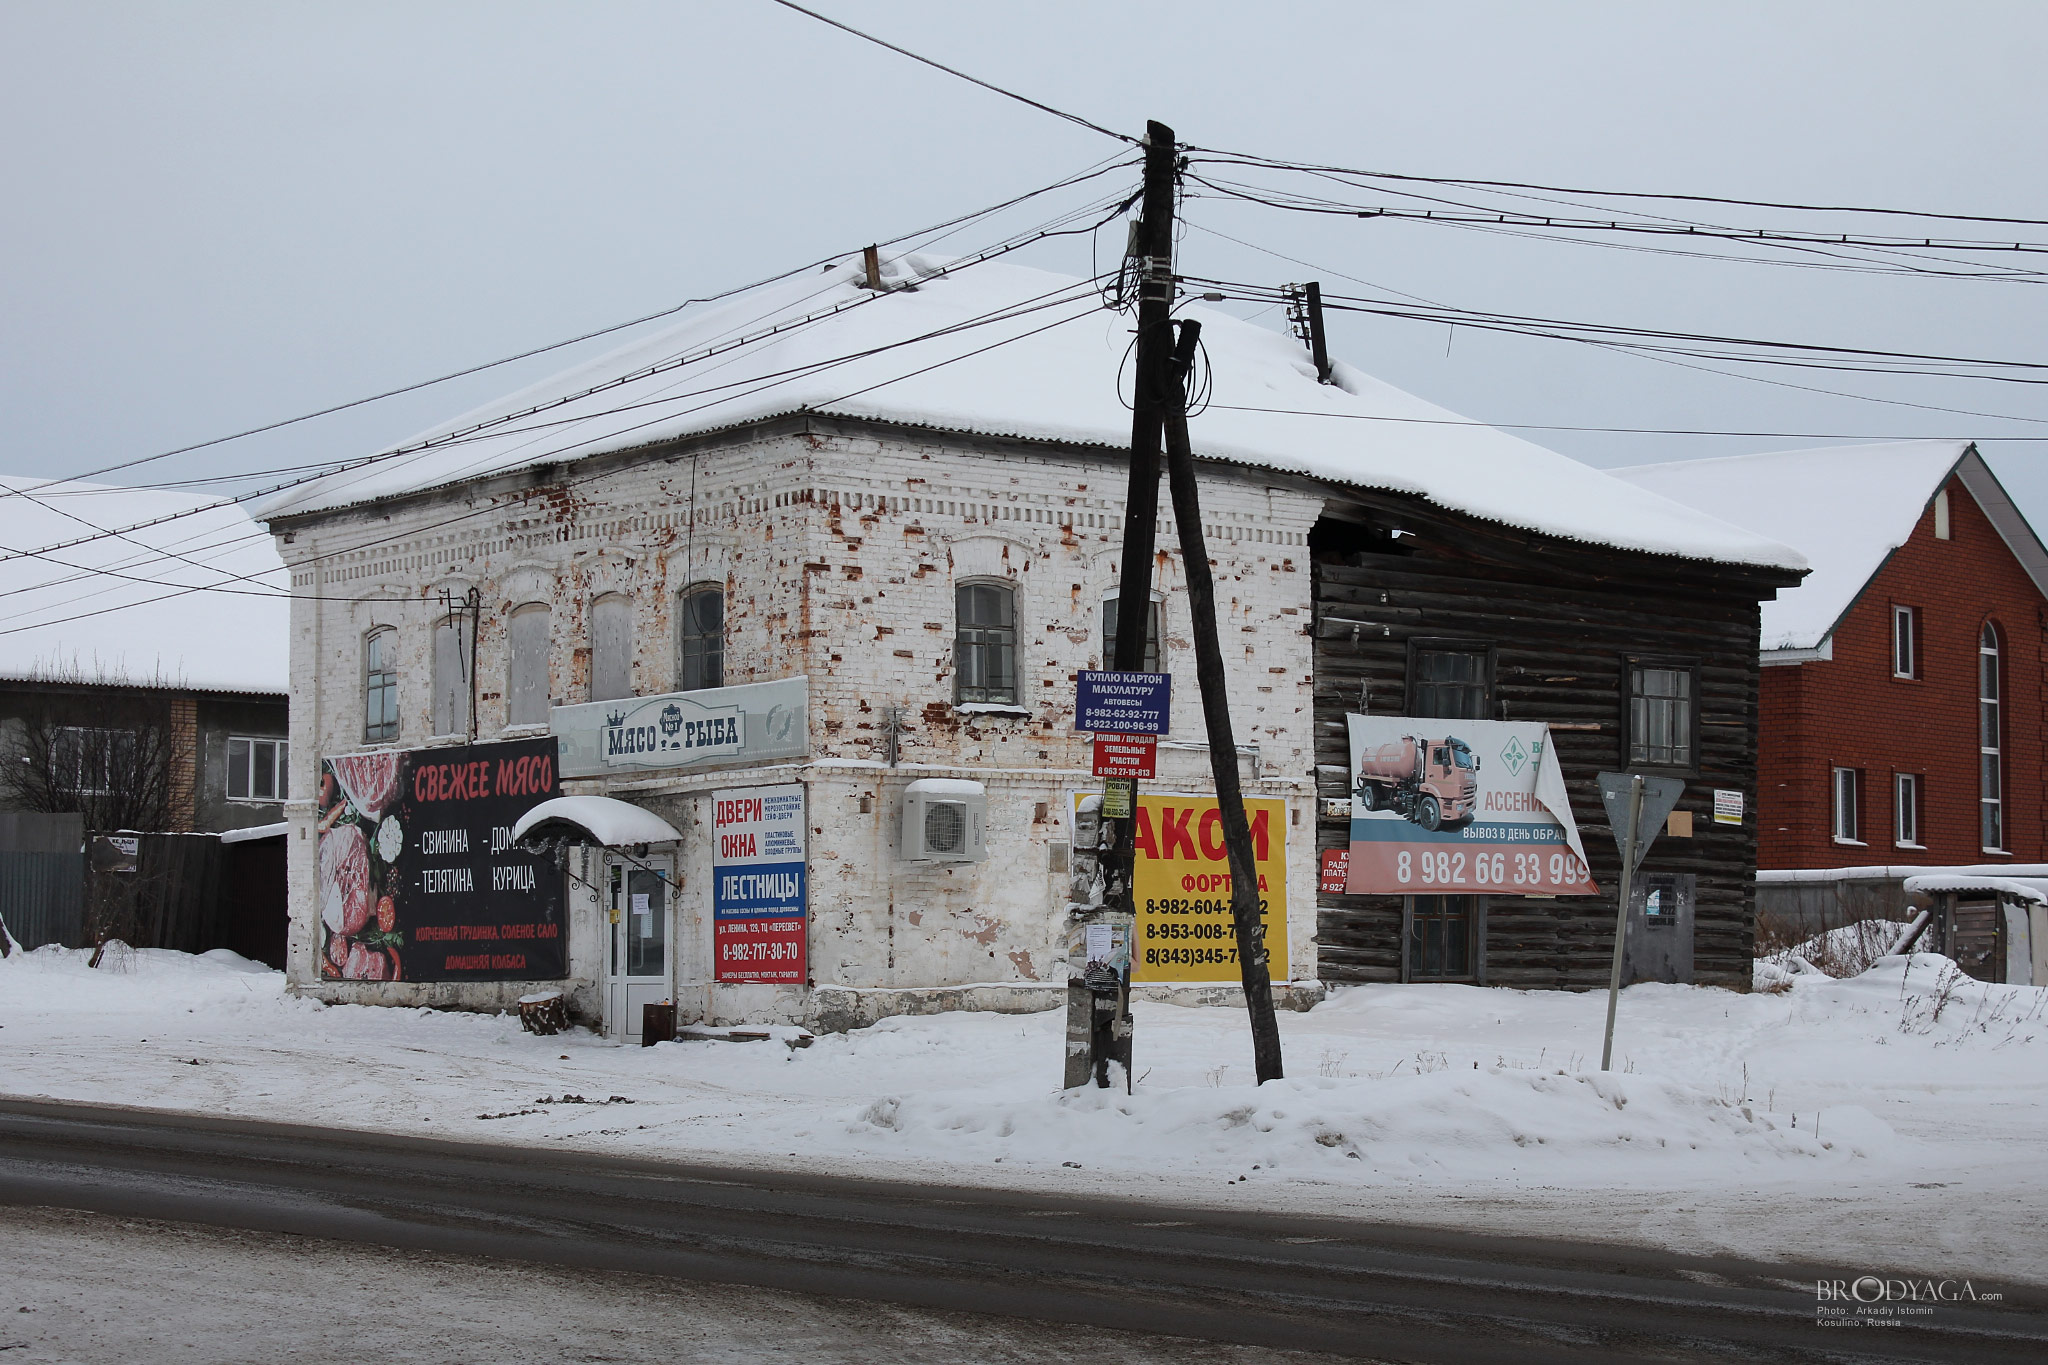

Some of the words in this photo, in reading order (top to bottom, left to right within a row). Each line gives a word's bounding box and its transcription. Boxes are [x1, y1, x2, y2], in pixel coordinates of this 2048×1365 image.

[1085, 672, 1120, 683] КУПЛЮ
[1123, 674, 1163, 684] КАРТОН
[1092, 685, 1154, 695] МАКУЛАТУРУ
[1103, 698, 1142, 706] АВТОВЕСЫ
[1085, 708, 1160, 719] 8-982-62-92-777
[1085, 720, 1159, 731] 8-922-100-96-99
[608, 725, 656, 756] МЯСО
[685, 717, 738, 748] РЫБА
[1096, 734, 1121, 742] КУПЛЮ
[1126, 735, 1155, 744] ПРОДАМ
[1104, 745, 1146, 754] ЗЕМЕЛЬНЫЕ
[1109, 757, 1140, 765] УЧАСТКИ
[415, 761, 490, 802] СВЕЖЕЕ
[495, 755, 552, 797] МЯСО
[1118, 769, 1150, 777] 27-16-813
[716, 798, 762, 828] ДВЕРИ
[764, 812, 793, 821] СЕЙФ-ДВЕРИ
[422, 829, 469, 854] СВИНИНА
[1134, 806, 1269, 861] АКСИ
[1463, 827, 1498, 839] ВЫВОЗ
[1500, 828, 1506, 839] В
[1507, 828, 1530, 841] ДЕНЬ
[721, 833, 757, 858] ОКНА
[1397, 851, 1412, 884] 8
[1421, 852, 1466, 883] 982
[1475, 852, 1505, 884] 66
[1514, 853, 1541, 884] 33
[422, 868, 474, 893] ТЕЛЯТИНА
[493, 865, 536, 893] КУРИЦА
[1181, 874, 1268, 893] ФОРТА
[1322, 883, 1328, 891] 8
[721, 873, 799, 902] ЛЕСТНИЦЫ
[1146, 899, 1268, 915] 8-982-604-72
[416, 926, 458, 941] КОПЧЕННАЯ
[501, 924, 535, 939] СОЛЕНОЕ
[537, 923, 558, 938] САЛО
[728, 923, 748, 934] ЛЕНИНА,
[761, 922, 769, 933] ТЦ
[1146, 923, 1268, 939] 8-953-008-77
[723, 942, 798, 960] 8-982-717-30-70
[445, 954, 490, 970] ДОМАШНЯЯ
[492, 954, 526, 969] КОЛБАСА
